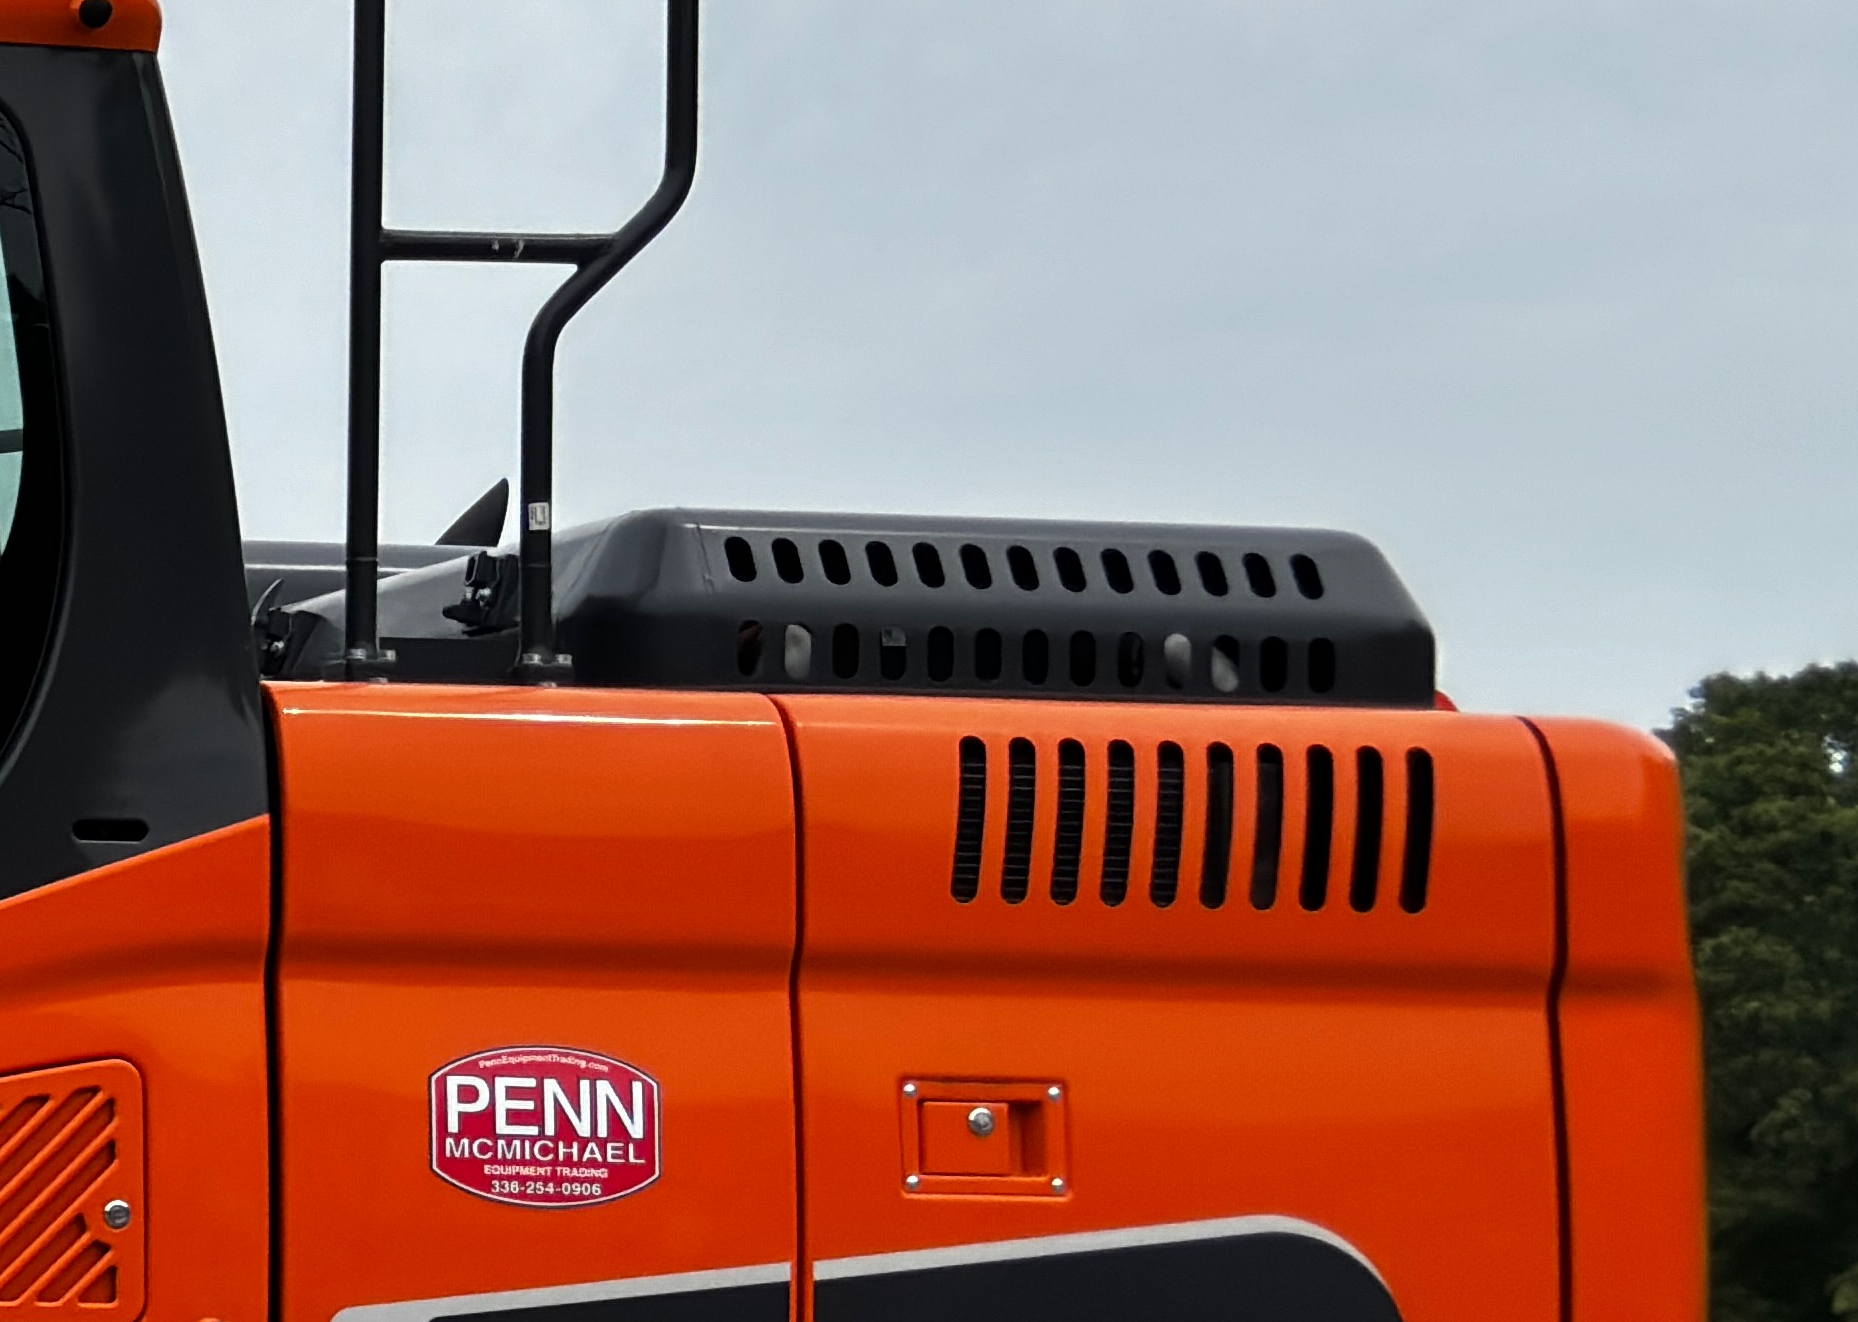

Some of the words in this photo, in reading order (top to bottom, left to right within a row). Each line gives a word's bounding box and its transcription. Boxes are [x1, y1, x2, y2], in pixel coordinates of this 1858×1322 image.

[446, 1075, 643, 1139] PENN
[445, 1138, 646, 1164] MCMICHAEL
[483, 1164, 552, 1177] EQUIPMENT
[555, 1166, 608, 1179] TRADING
